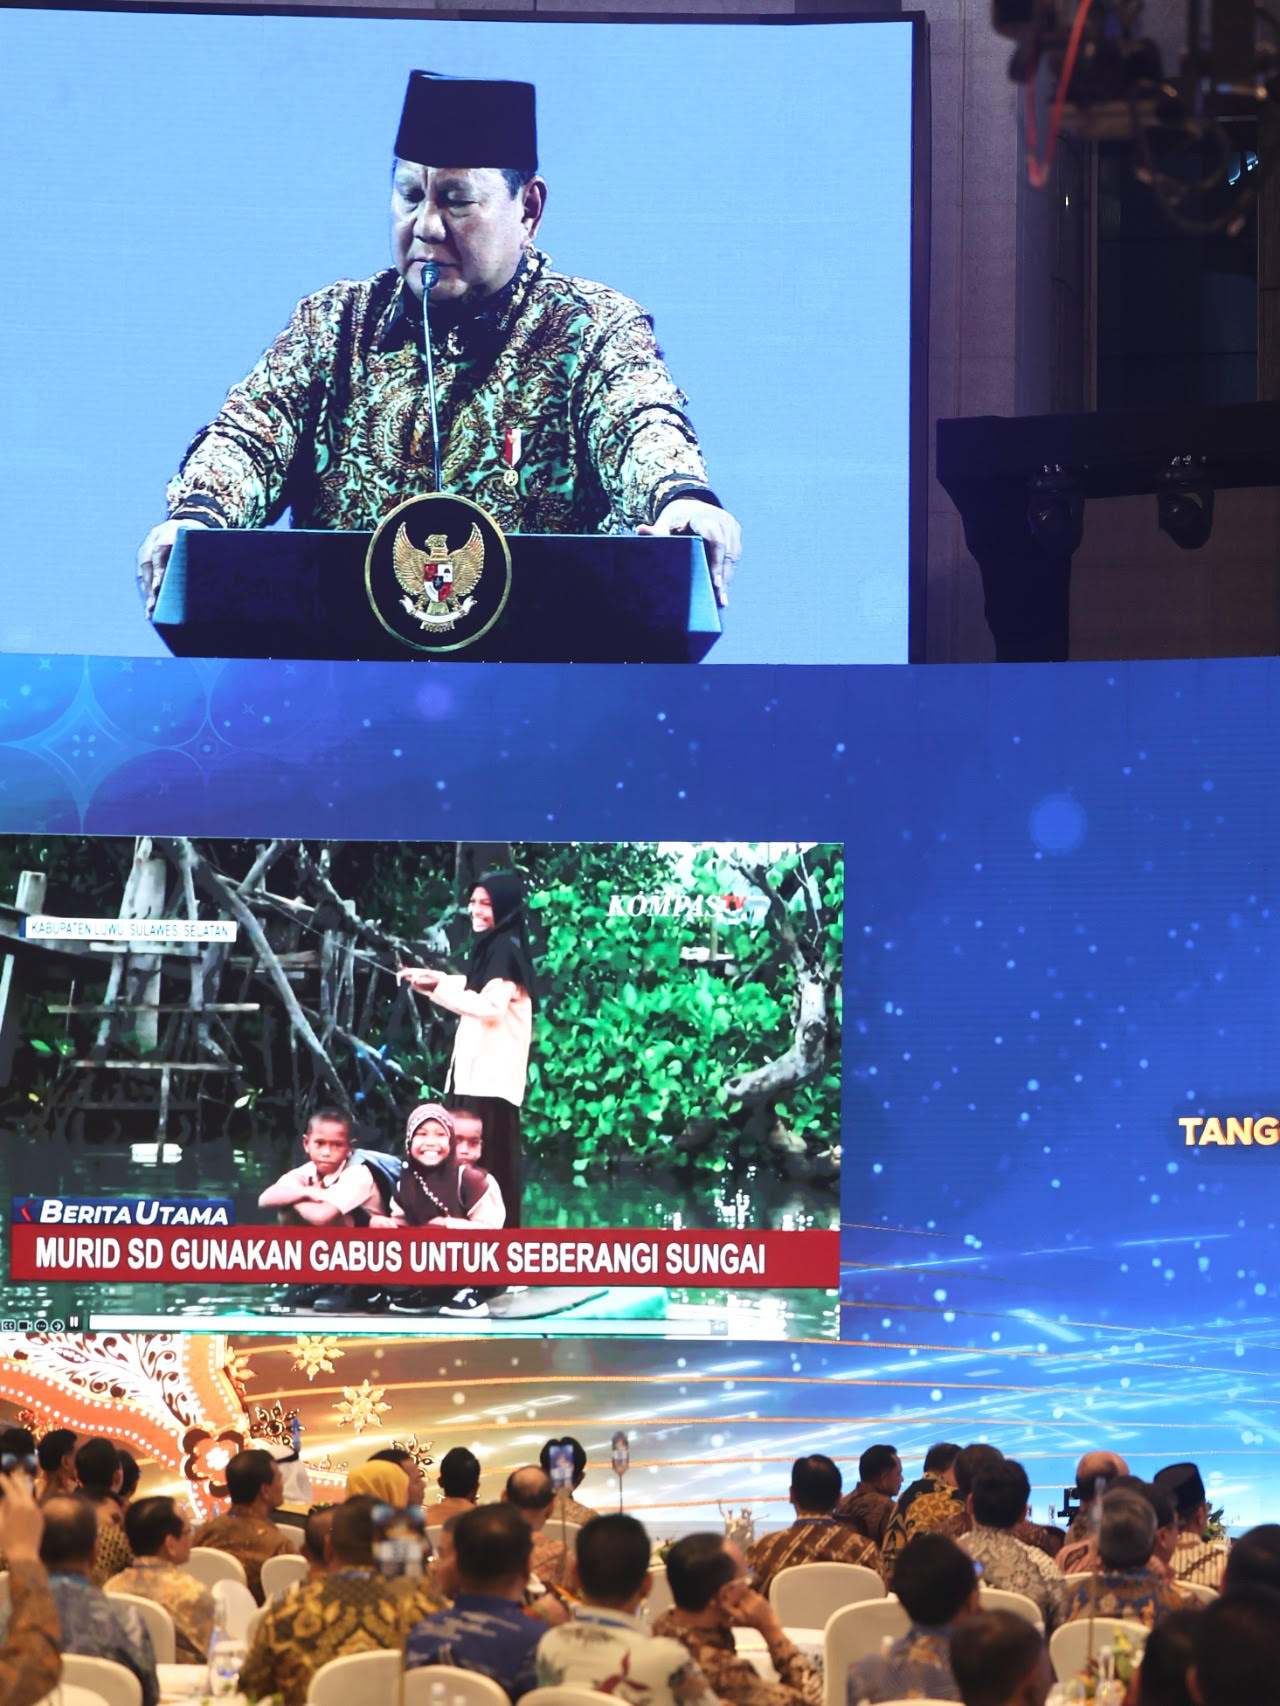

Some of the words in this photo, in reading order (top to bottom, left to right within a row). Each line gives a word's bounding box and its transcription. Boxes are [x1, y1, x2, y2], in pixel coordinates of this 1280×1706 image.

[31, 921, 91, 936] KABUPATEN
[129, 923, 182, 937] SULAWES
[184, 924, 229, 938] SELATAN
[39, 1199, 132, 1225] BERITA
[135, 1200, 229, 1226] UTAMA
[35, 1237, 121, 1269] MURID
[127, 1237, 164, 1270] SD
[170, 1238, 302, 1271] GUNAKAN
[309, 1239, 402, 1272] GABUS
[410, 1241, 500, 1273] UNTUK
[506, 1241, 659, 1274] SEBERANGI
[665, 1242, 765, 1275] SUNGAI
